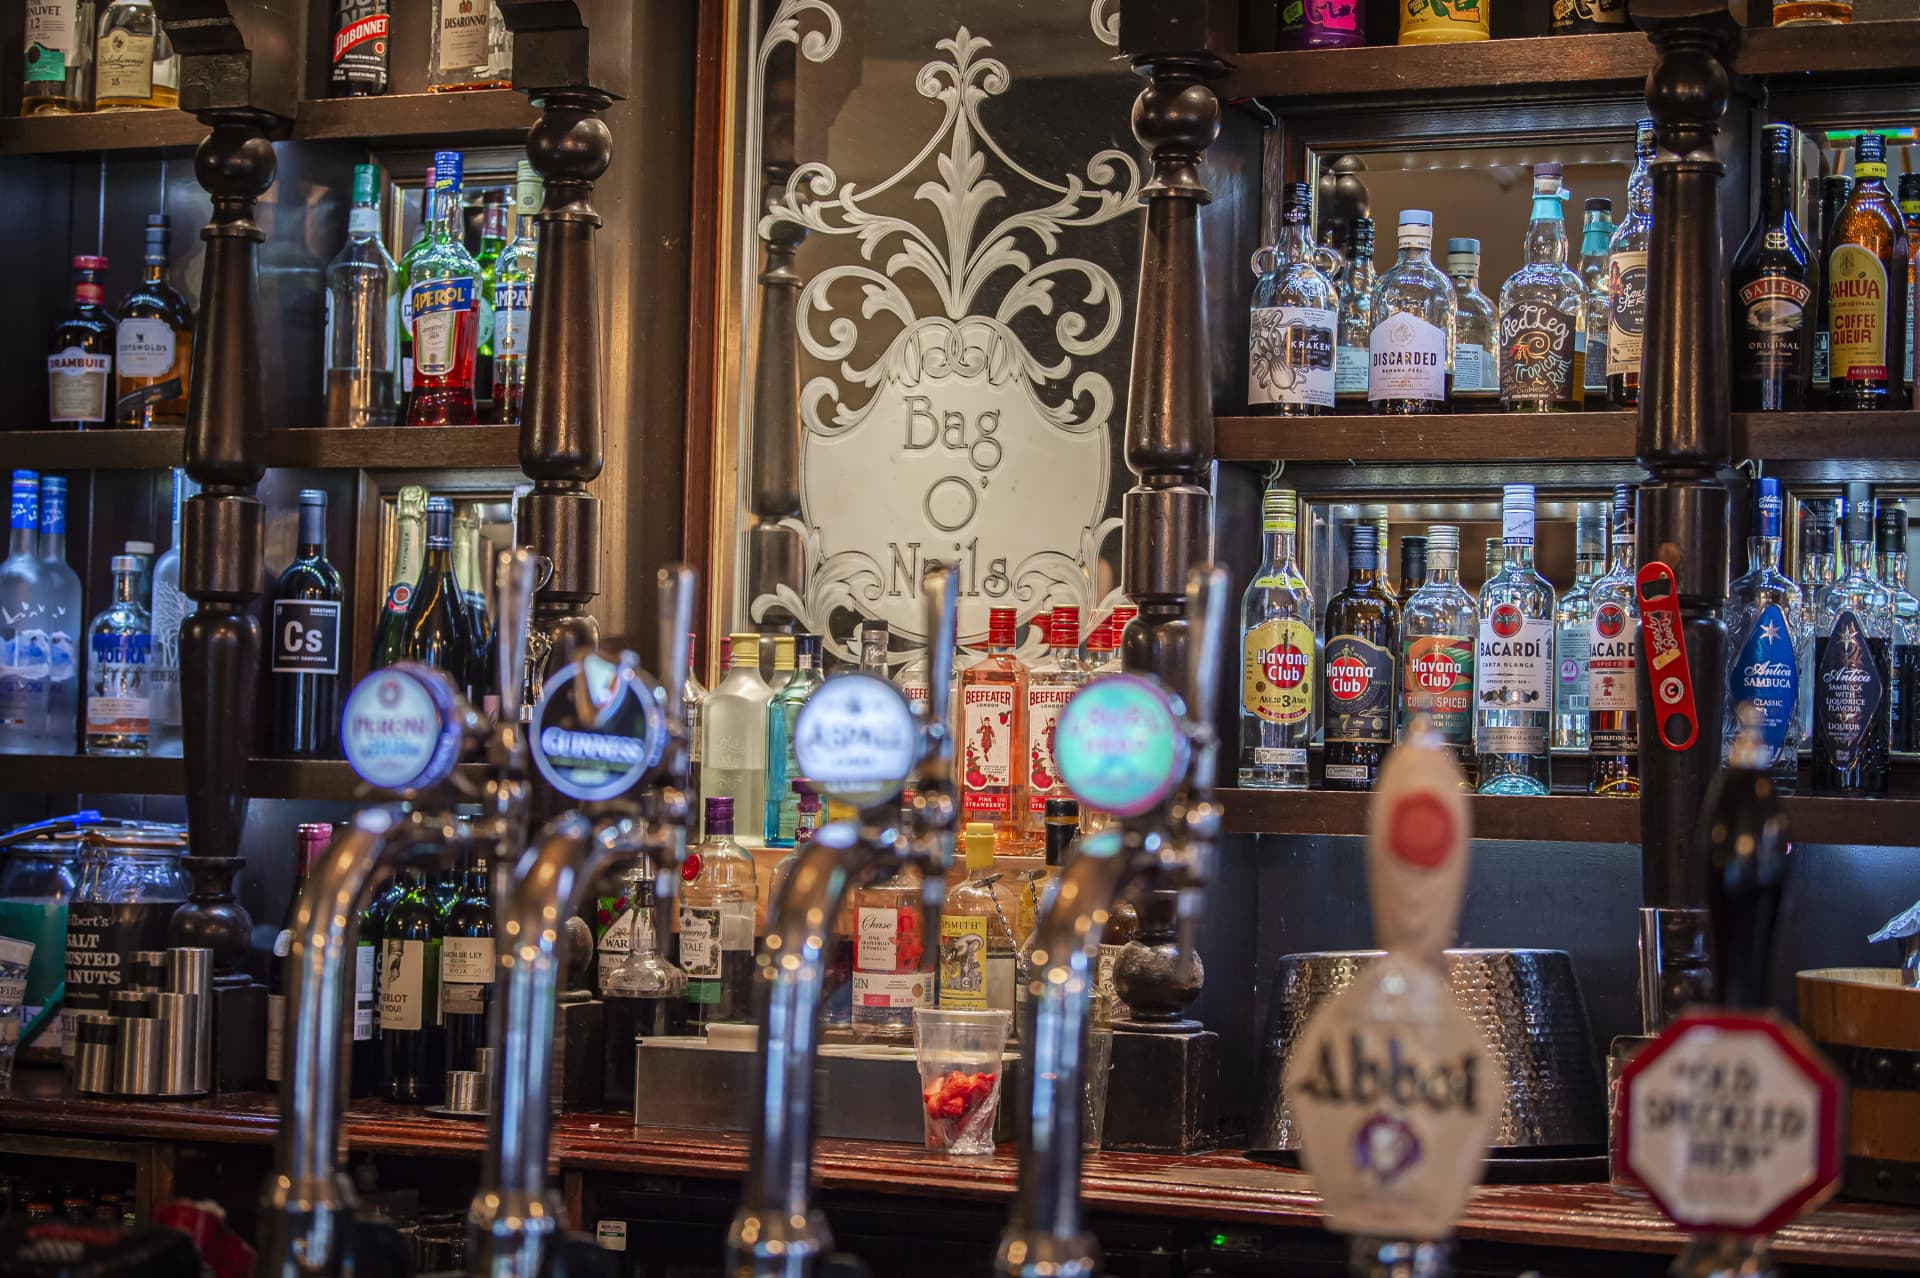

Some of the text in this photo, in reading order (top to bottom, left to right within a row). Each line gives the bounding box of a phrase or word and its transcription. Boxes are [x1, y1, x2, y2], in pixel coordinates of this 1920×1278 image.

[30, 18, 41, 30] 12
[444, 14, 486, 29] DISARONNO
[336, 18, 387, 55] DUBONNET
[1743, 281, 1808, 300] BAILEYS
[413, 287, 465, 313] APEROL
[1501, 302, 1569, 351] Red Leg
[1834, 313, 1877, 330] COFFEE
[1290, 341, 1331, 351] KRAKEN
[50, 356, 106, 370] DRAMBUIE
[1373, 351, 1437, 367] DISCARDED
[1513, 350, 1563, 384] Tropical
[1546, 359, 1572, 391] Rum
[903, 395, 1002, 471] Bag
[888, 536, 1011, 599] Nils
[284, 620, 323, 653] Cs
[1480, 638, 1541, 658] BACARDÍ
[97, 649, 146, 665] VODKA
[1257, 648, 1309, 665] Havana
[1268, 665, 1301, 681] Club
[1326, 662, 1374, 677] Havana
[1412, 658, 1462, 673] Havana
[1503, 661, 1535, 669] BLANCA
[1743, 660, 1792, 677] Antica
[1420, 673, 1451, 687] Club
[1822, 666, 1872, 683] Antica
[1332, 677, 1361, 692] Club
[1743, 677, 1791, 689] SAMBUCA
[1828, 683, 1863, 692] SAMBUCA
[965, 690, 1012, 706] BEEFEATER
[1281, 694, 1292, 708] 3
[1436, 696, 1467, 708] SPICED
[1753, 697, 1783, 707] CLASSIC
[1339, 713, 1351, 732] 7
[1828, 722, 1860, 731] LIQUEUR
[965, 802, 1006, 810] STRAWBERRY
[861, 913, 893, 931] Chase
[469, 951, 483, 959] LEY
